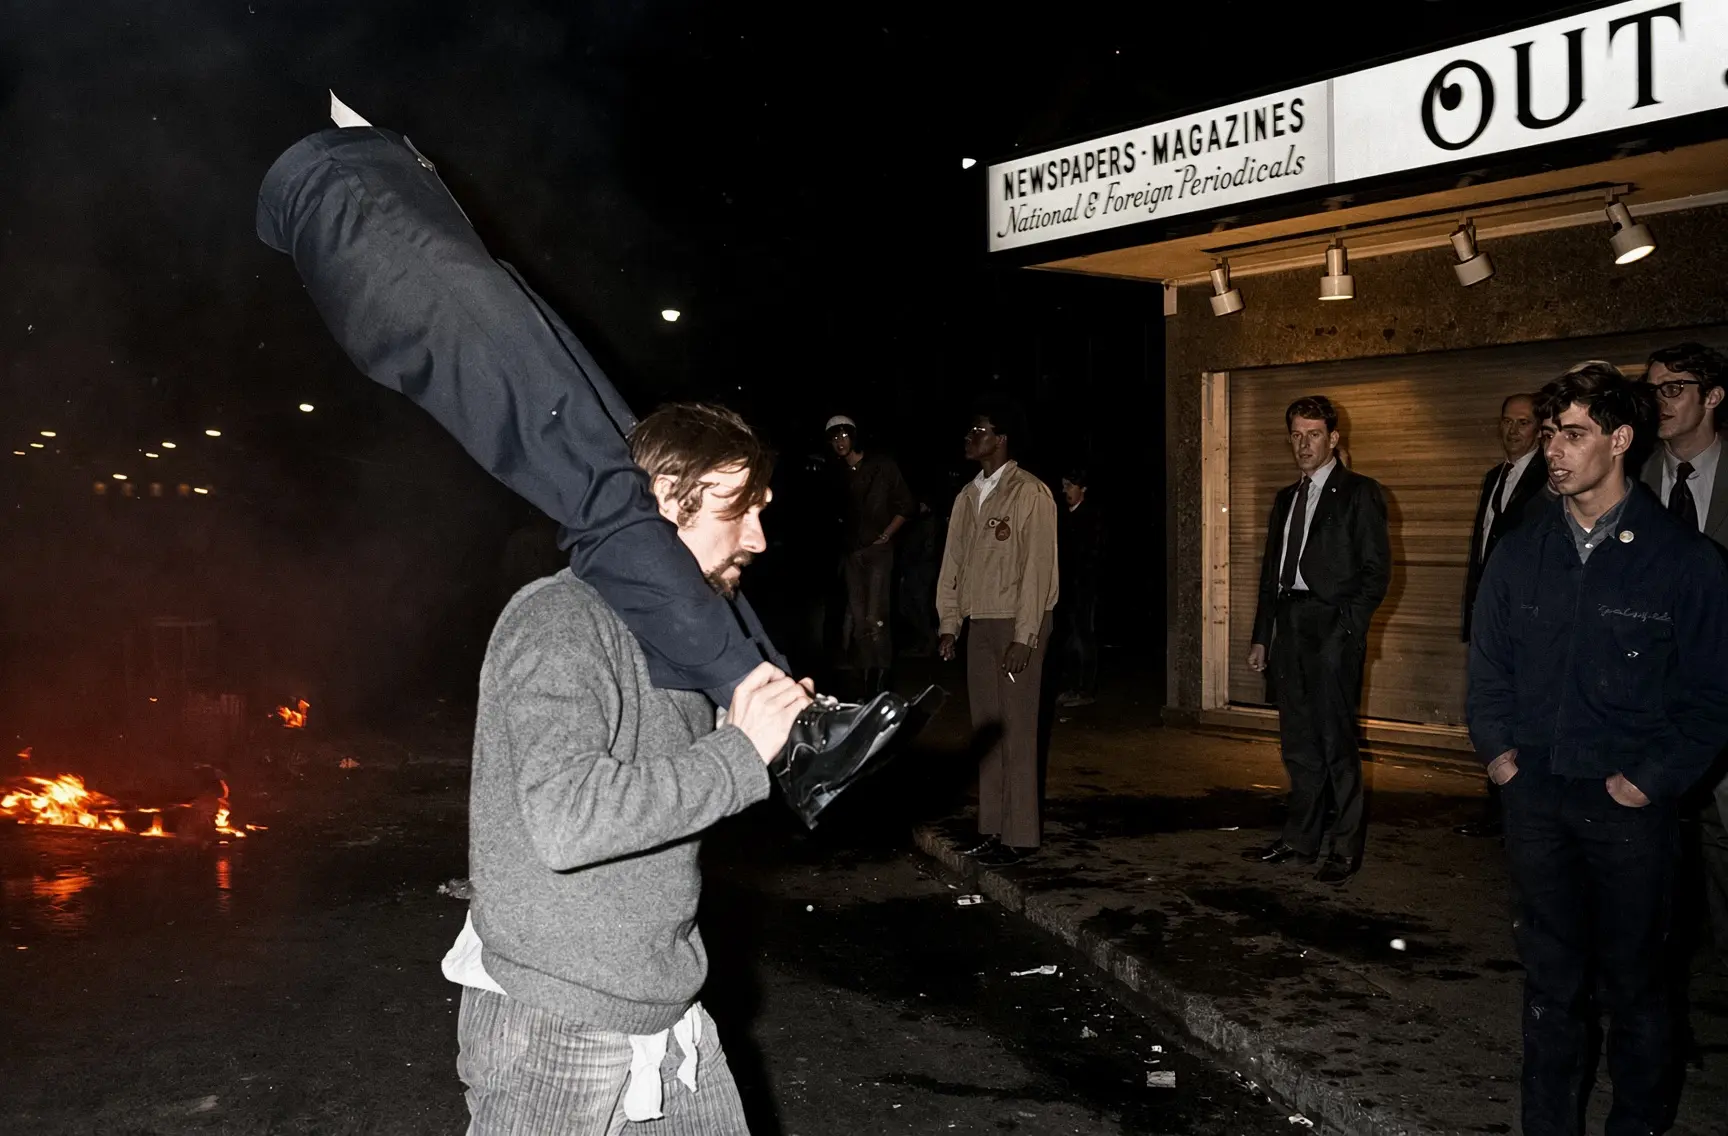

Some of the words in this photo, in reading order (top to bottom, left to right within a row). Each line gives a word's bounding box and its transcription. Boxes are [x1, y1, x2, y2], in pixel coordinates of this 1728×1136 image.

[1421, 2, 1685, 151] OUT
[996, 193, 1082, 238] National
[1084, 191, 1099, 219] &
[1102, 181, 1173, 214] Foreign
[1174, 144, 1306, 199] Periodicals
[1003, 141, 1136, 201] NEWSPAPERS
[1152, 97, 1305, 165] MAGAZINES
